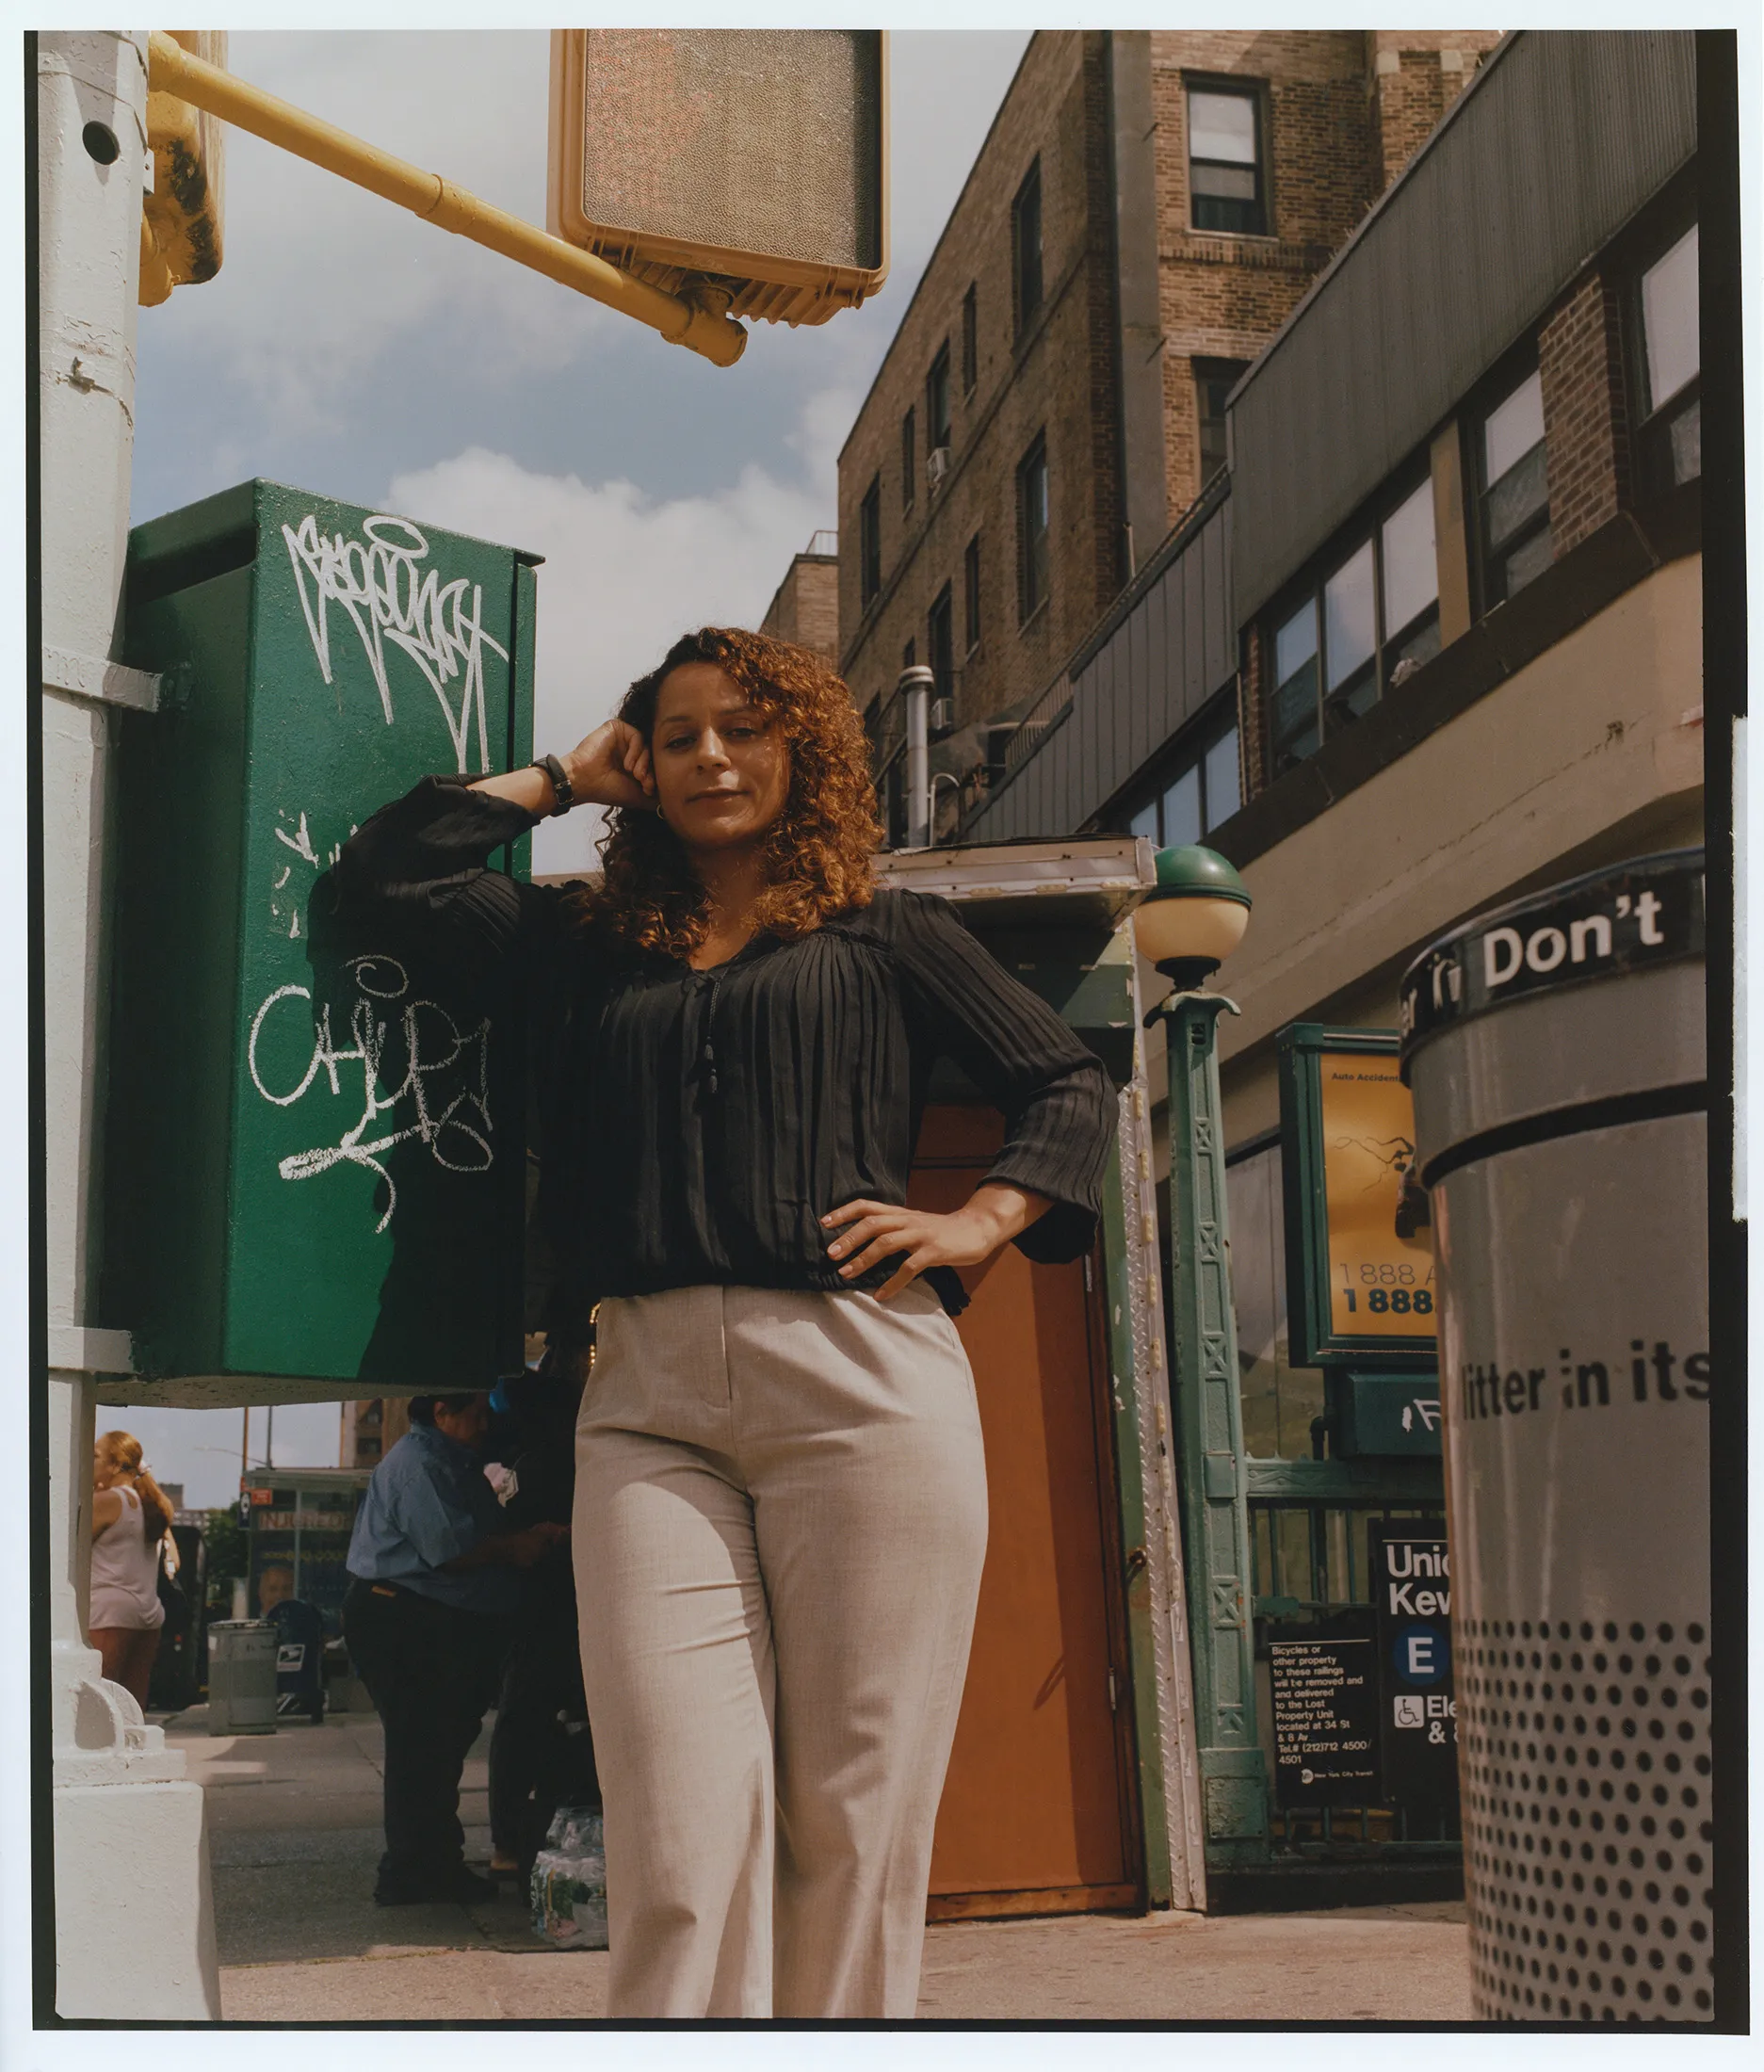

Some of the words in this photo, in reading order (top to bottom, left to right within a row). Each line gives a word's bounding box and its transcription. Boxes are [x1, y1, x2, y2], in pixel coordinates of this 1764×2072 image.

[1483, 890, 1664, 987] Don't
[1340, 1263, 1350, 1284] 1
[1360, 1263, 1416, 1286] 888
[1343, 1288, 1356, 1313] 1
[1368, 1288, 1433, 1315] 888
[1462, 1362, 1546, 1420] litter
[1559, 1348, 1610, 1409] in
[1631, 1338, 1709, 1402] its
[1271, 1646, 1308, 1656] Bicycles
[1408, 1637, 1434, 1674] E
[1272, 1658, 1296, 1666] other
[1299, 1656, 1336, 1665] property
[1314, 1666, 1344, 1675] railings
[1274, 1679, 1288, 1688] will
[1290, 1678, 1303, 1687] be
[1305, 1676, 1344, 1687] removed
[1347, 1675, 1363, 1685] and
[1275, 1690, 1291, 1698] and
[1294, 1688, 1334, 1698] delivered
[1275, 1701, 1285, 1709] to
[1287, 1700, 1302, 1708] the
[1305, 1699, 1325, 1708] Lost
[1275, 1710, 1314, 1721] Property
[1317, 1709, 1334, 1719] Unit
[1276, 1722, 1309, 1731] located
[1313, 1722, 1321, 1730] at
[1324, 1721, 1336, 1729] 34
[1340, 1720, 1351, 1729] St
[1278, 1734, 1285, 1742] &
[1298, 1733, 1309, 1741] Av
[1428, 1721, 1447, 1743] &
[1279, 1755, 1302, 1764] 4501
